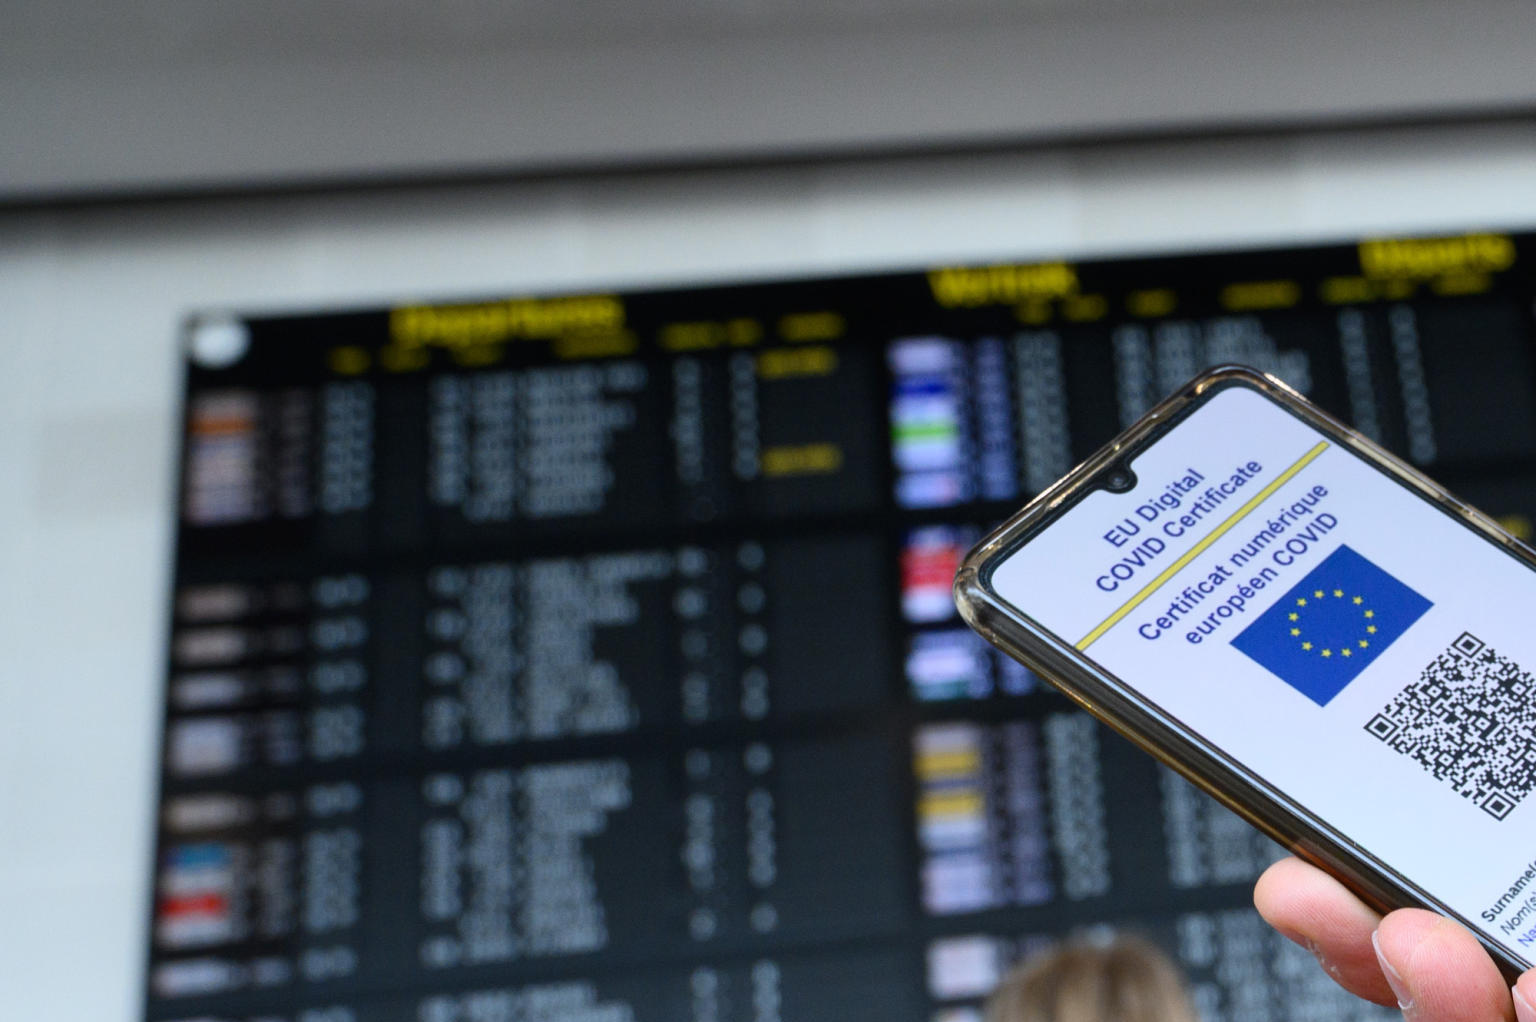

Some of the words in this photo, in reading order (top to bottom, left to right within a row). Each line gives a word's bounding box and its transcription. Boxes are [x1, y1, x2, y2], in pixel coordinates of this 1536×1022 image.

[1096, 537, 1166, 592] COVID
[1163, 461, 1262, 538] Certificate
[1103, 519, 1141, 548] EU
[1135, 468, 1205, 522] Digital
[1138, 565, 1233, 640] Certificat
[1230, 485, 1328, 567] numérique
[1186, 567, 1279, 644] européen
[1273, 512, 1338, 566] COVID
